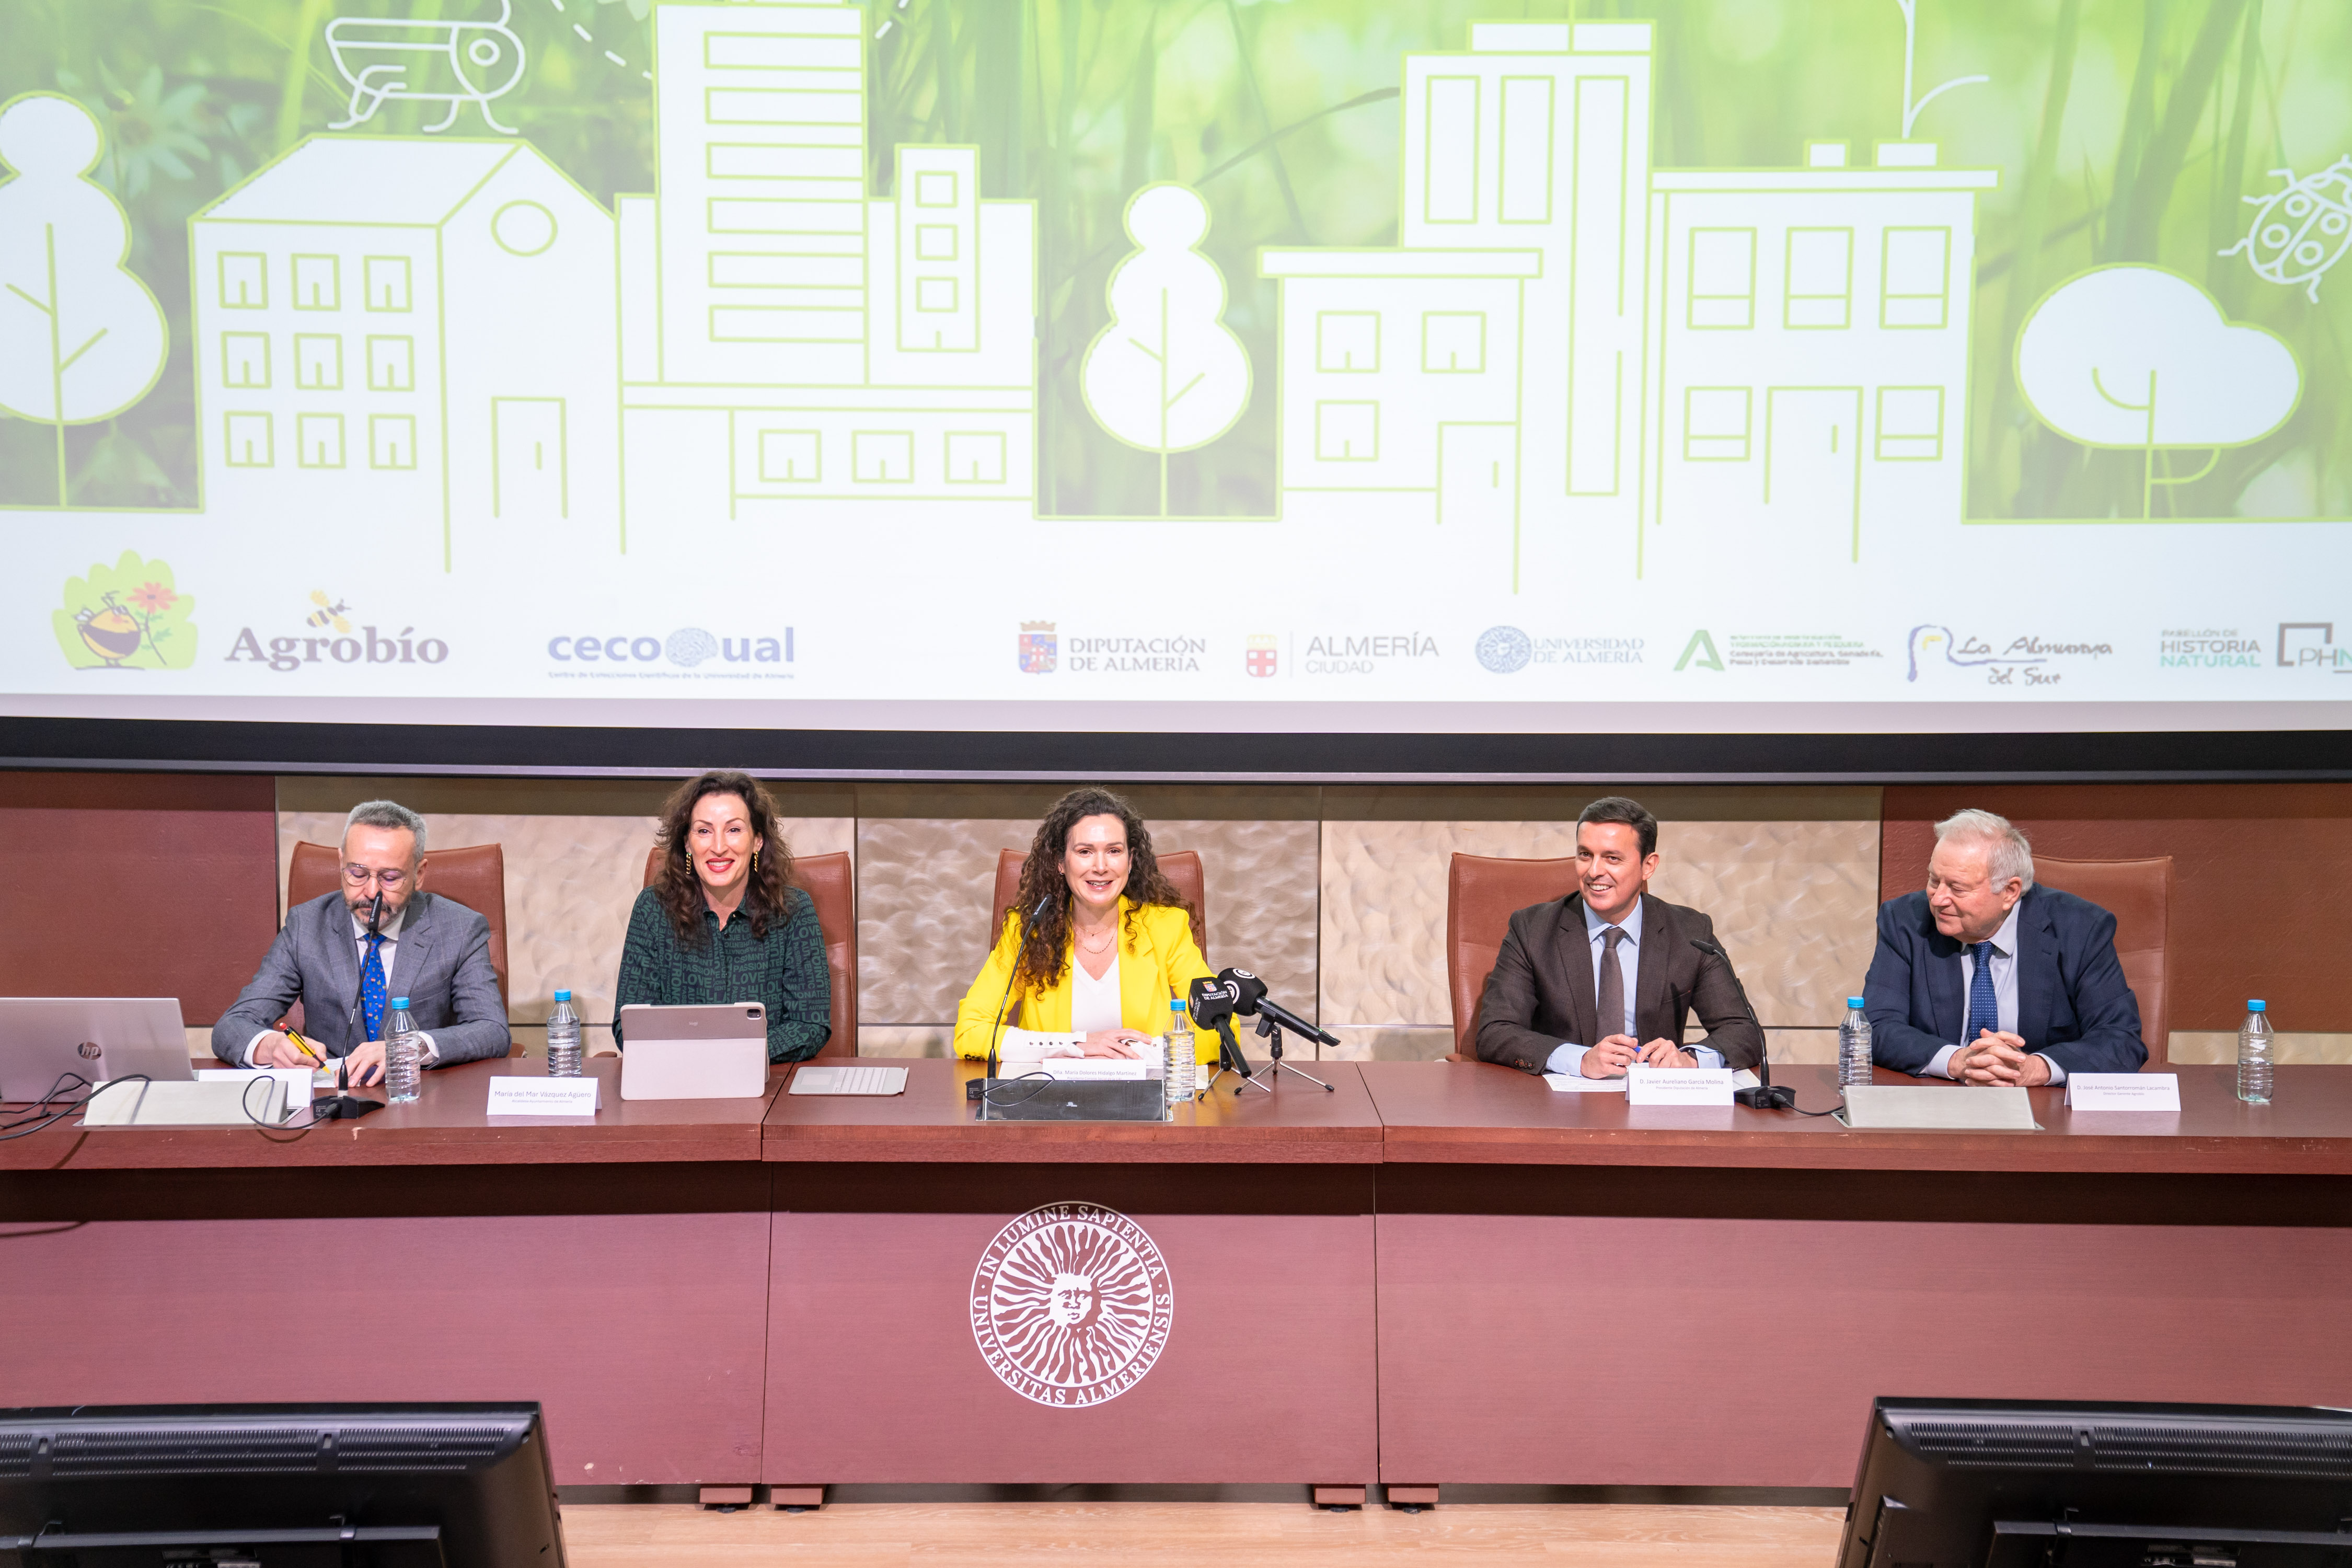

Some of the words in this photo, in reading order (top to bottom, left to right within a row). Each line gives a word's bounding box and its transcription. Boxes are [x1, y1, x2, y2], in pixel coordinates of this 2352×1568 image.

[224, 626, 449, 672] Agrobío
[1069, 635, 1206, 653] DIPUTACIÓN
[1306, 631, 1440, 657] ALMERÍA
[1534, 638, 1644, 649] UNIVERSIDAD
[1956, 636, 1991, 654] La
[2160, 640, 2262, 653] HISTORIA
[1069, 657, 1098, 671] DE
[1104, 654, 1200, 672] ALMERÍA
[1534, 651, 1558, 663] DE
[1562, 650, 1643, 663] ALMERÍA
[2160, 654, 2262, 667] NATURAL
[1305, 660, 1374, 674] CIUDAD
[1987, 667, 2014, 685] del
[2023, 667, 2061, 686] Sur
[791, 925, 822, 941] LOVE
[809, 938, 825, 989] UNIQUE
[732, 971, 766, 985] LOVE
[80, 1042, 99, 1060] hp
[979, 1254, 997, 1279] IN
[994, 1205, 1071, 1252] LUMINE
[1077, 1205, 1164, 1280] SAPIENTIA
[973, 1294, 1066, 1405] UNIVERSITAS
[1075, 1293, 1171, 1405] ALMERIENSIS
